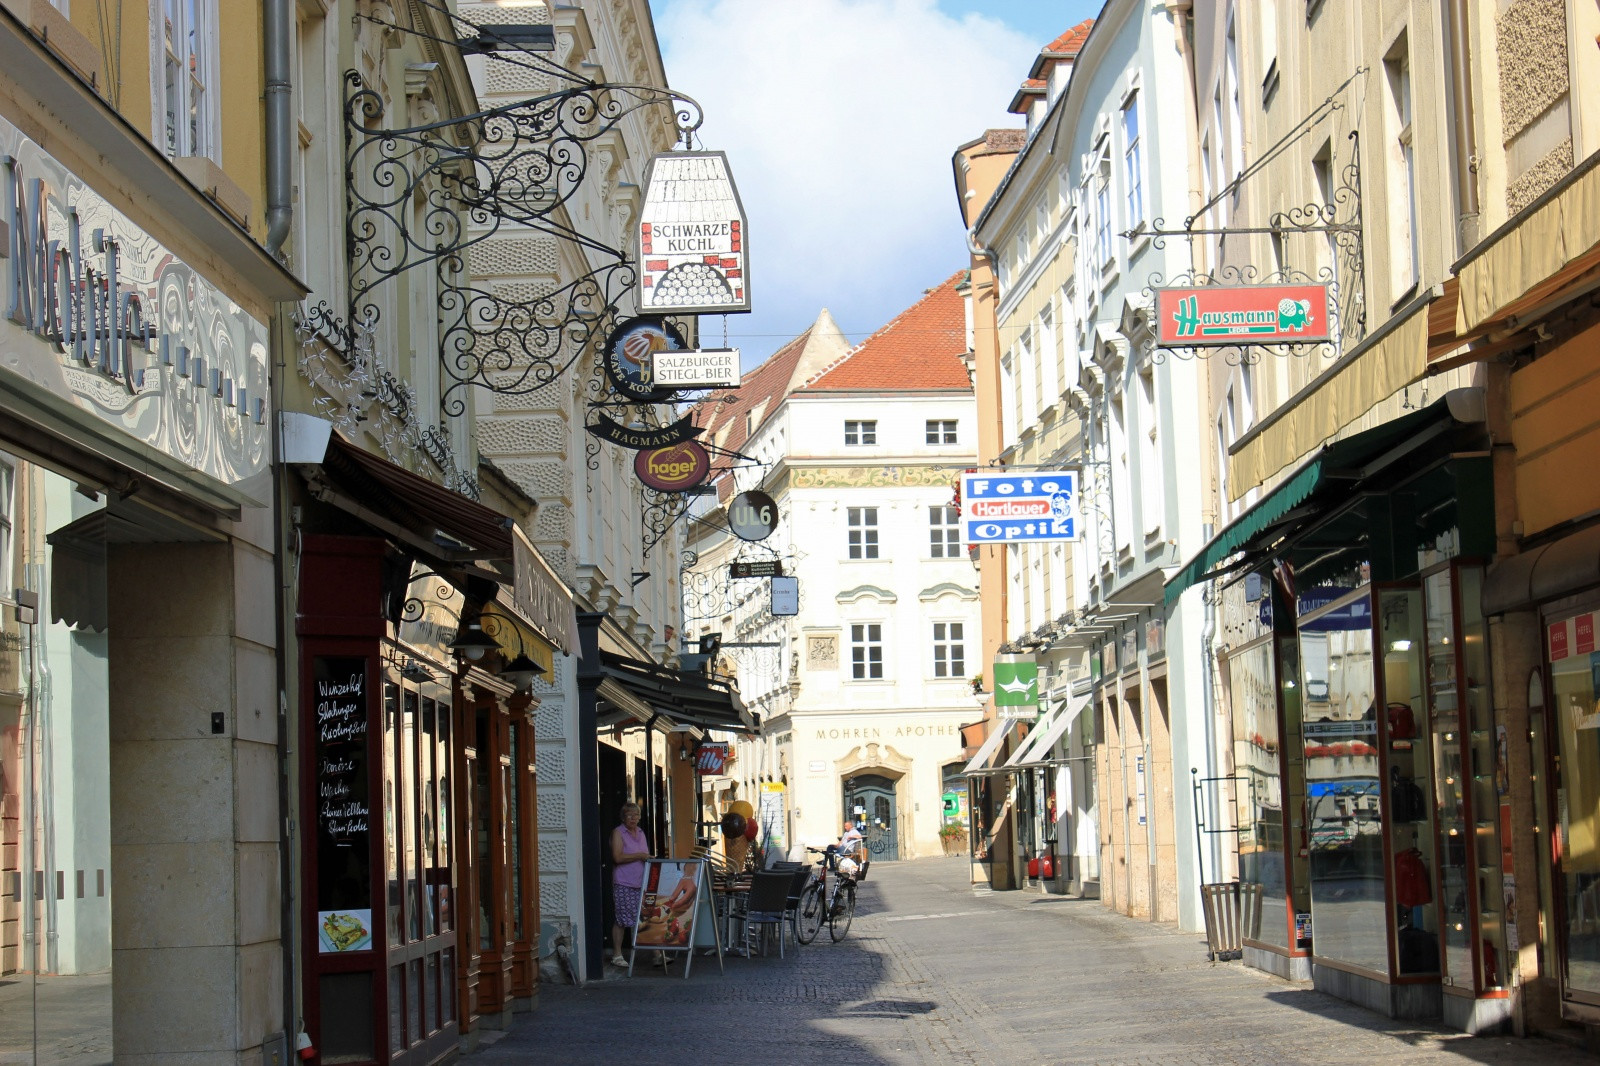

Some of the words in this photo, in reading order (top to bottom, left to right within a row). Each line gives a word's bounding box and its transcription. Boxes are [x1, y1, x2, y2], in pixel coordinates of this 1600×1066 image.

[653, 223, 730, 238] SCHWARZE
[668, 238, 715, 252] KUCHL
[1173, 294, 1276, 337] Hausmann
[658, 356, 732, 369] SALZBURGER
[659, 367, 733, 381] STIEGL-BIER
[628, 382, 655, 393] KON
[610, 428, 681, 446] HAGMANN
[648, 459, 697, 477] hager
[973, 479, 1060, 495] Foto
[735, 505, 772, 527] UL6
[976, 502, 1045, 516] Hartlauer
[975, 521, 1069, 539] Optik
[816, 727, 880, 740] MOHREN
[895, 725, 960, 738] APOTHE
[697, 751, 723, 774] illy
